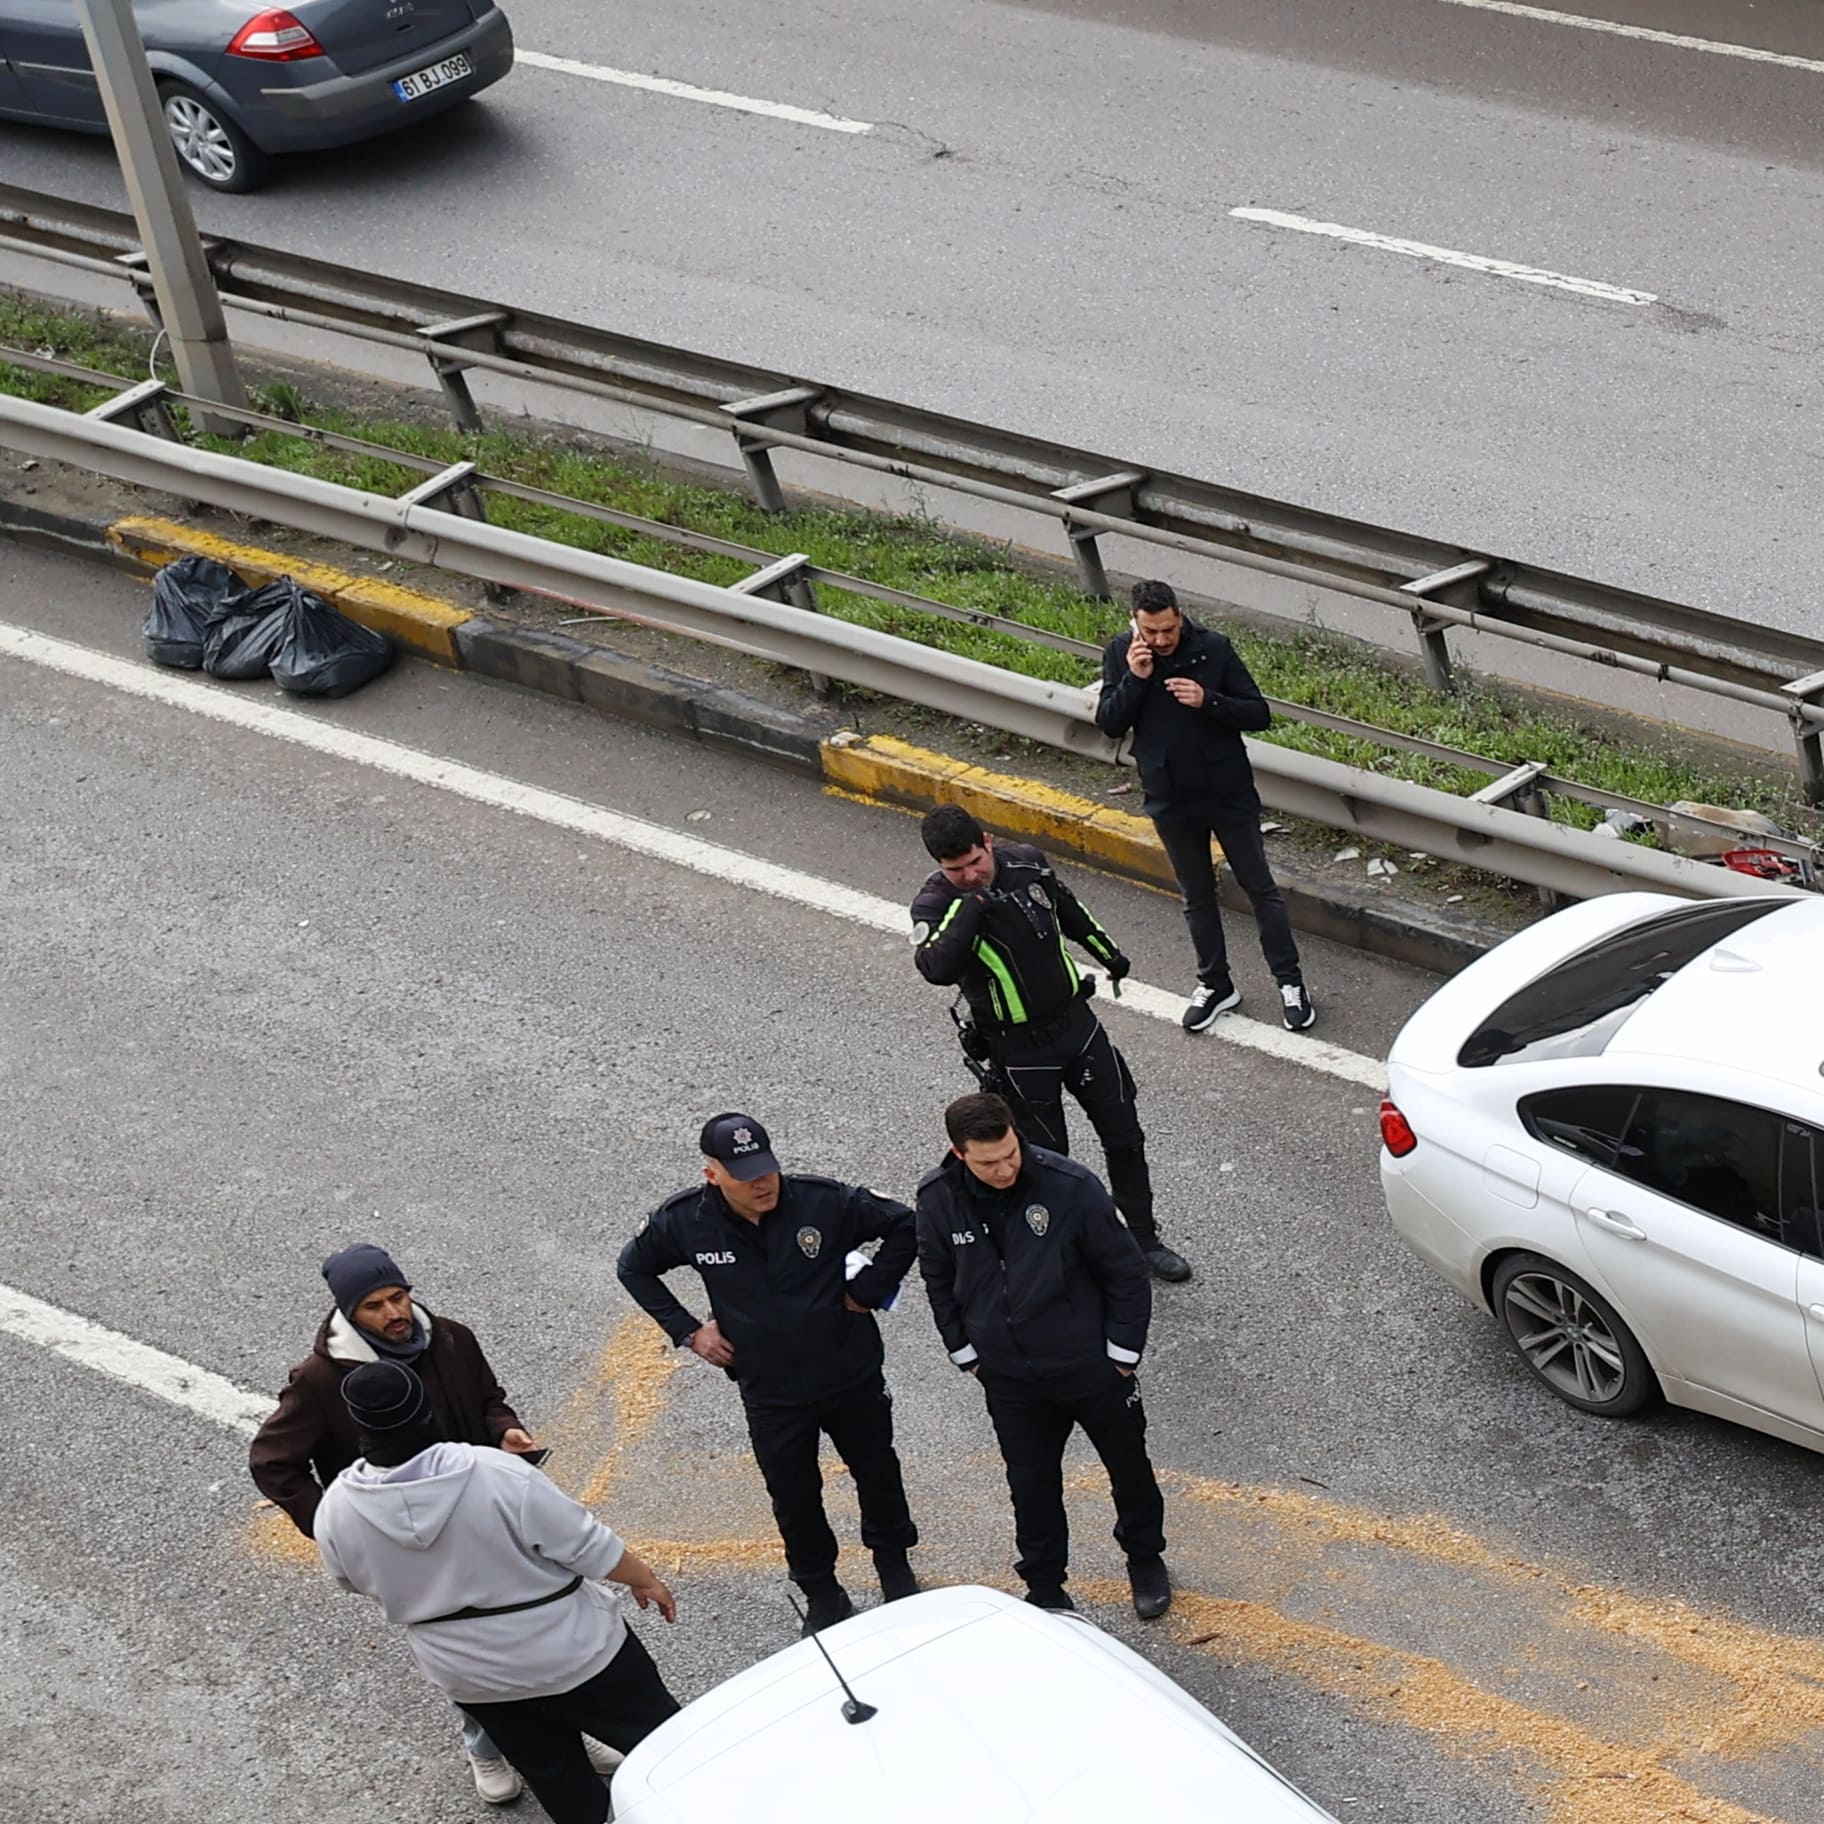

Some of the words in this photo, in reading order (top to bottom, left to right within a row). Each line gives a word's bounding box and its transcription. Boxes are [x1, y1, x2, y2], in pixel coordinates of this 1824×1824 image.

[402, 77, 420, 97] 61
[419, 68, 440, 89] BJ
[441, 57, 468, 79] 099
